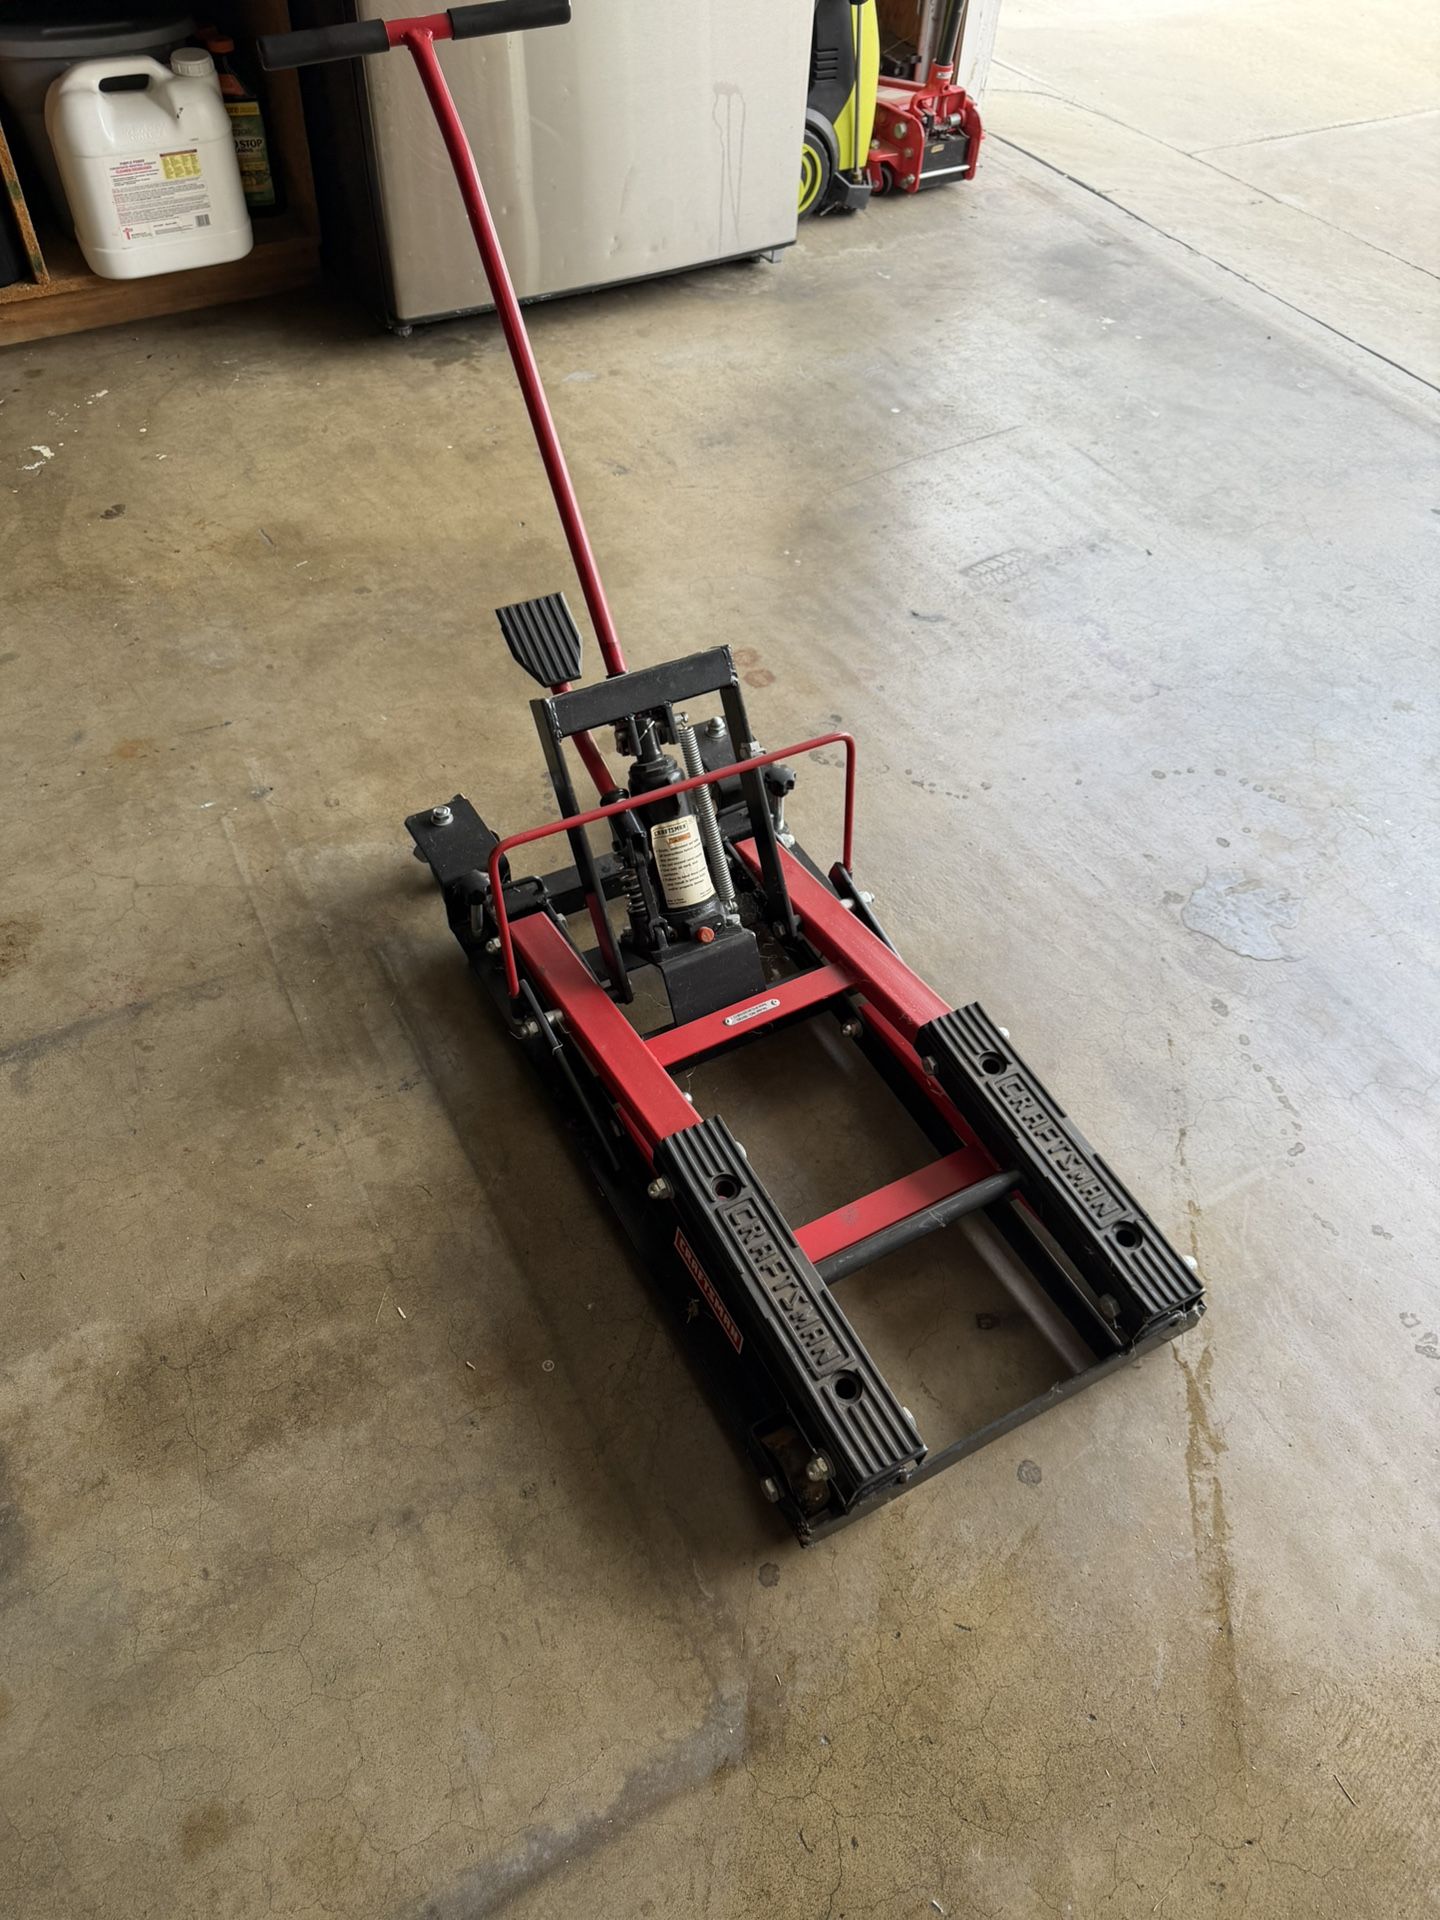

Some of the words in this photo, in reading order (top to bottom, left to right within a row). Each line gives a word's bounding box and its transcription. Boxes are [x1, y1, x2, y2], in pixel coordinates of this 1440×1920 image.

[240, 139, 263, 148] STOP
[999, 1080, 1120, 1219] CRAFTSMAN
[677, 1236, 740, 1347] CRAFTSMAN
[727, 1204, 842, 1369] CRAFTSMAN
